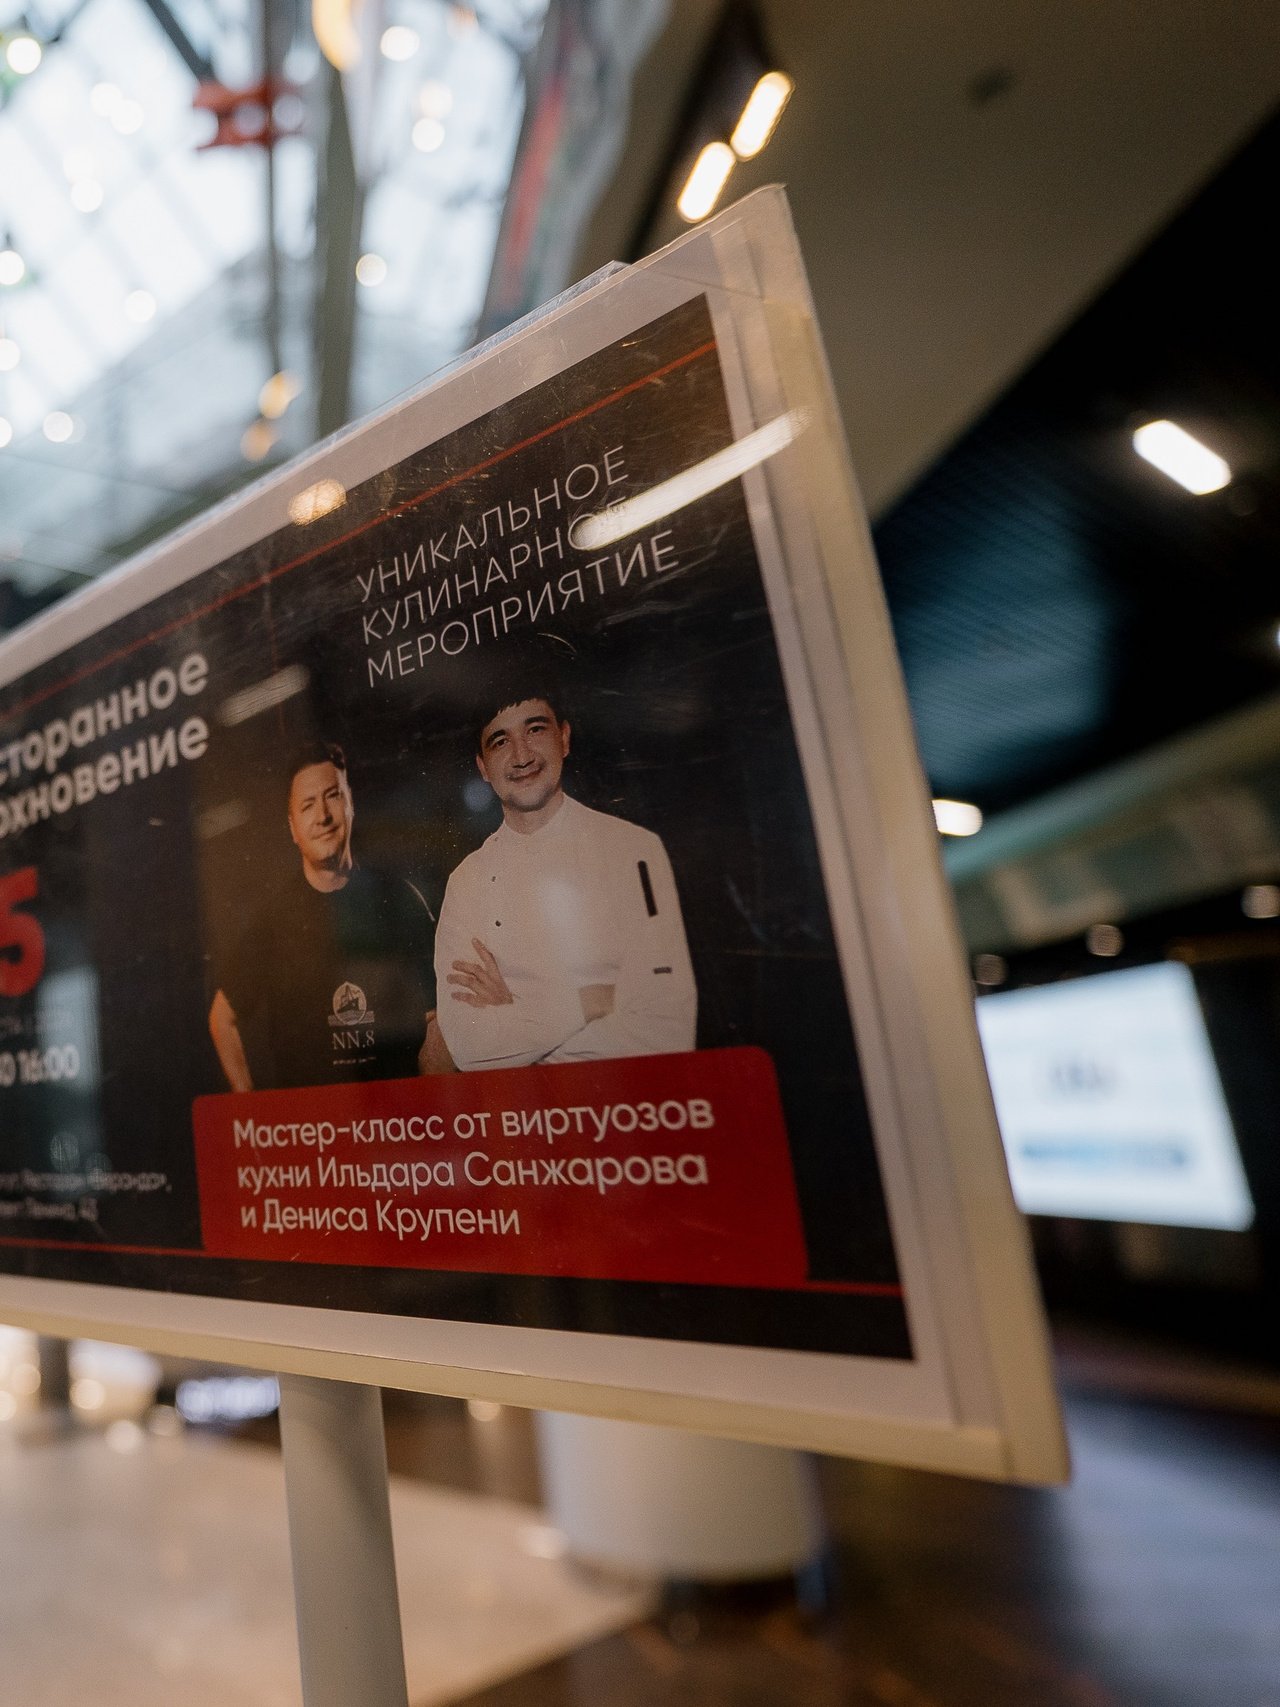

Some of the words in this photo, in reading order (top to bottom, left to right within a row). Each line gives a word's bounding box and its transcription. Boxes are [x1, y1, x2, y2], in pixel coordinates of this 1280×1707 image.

[356, 445, 629, 603] УНИКАЛЬНОЕ
[362, 496, 626, 645] КУЛИНАРНО
[367, 530, 679, 688] МЕРОПРИЯТИЕ
[332, 1030, 375, 1050] NN.8
[233, 1115, 445, 1153] Мастер-класс
[453, 1112, 491, 1139] от
[501, 1099, 715, 1144] виртуозов
[237, 1165, 311, 1195] кухни
[317, 1156, 455, 1195] Ильдара
[464, 1151, 709, 1195] Санжарова
[240, 1206, 257, 1228] и
[262, 1198, 368, 1234] Дениса
[375, 1199, 520, 1242] Крупени
